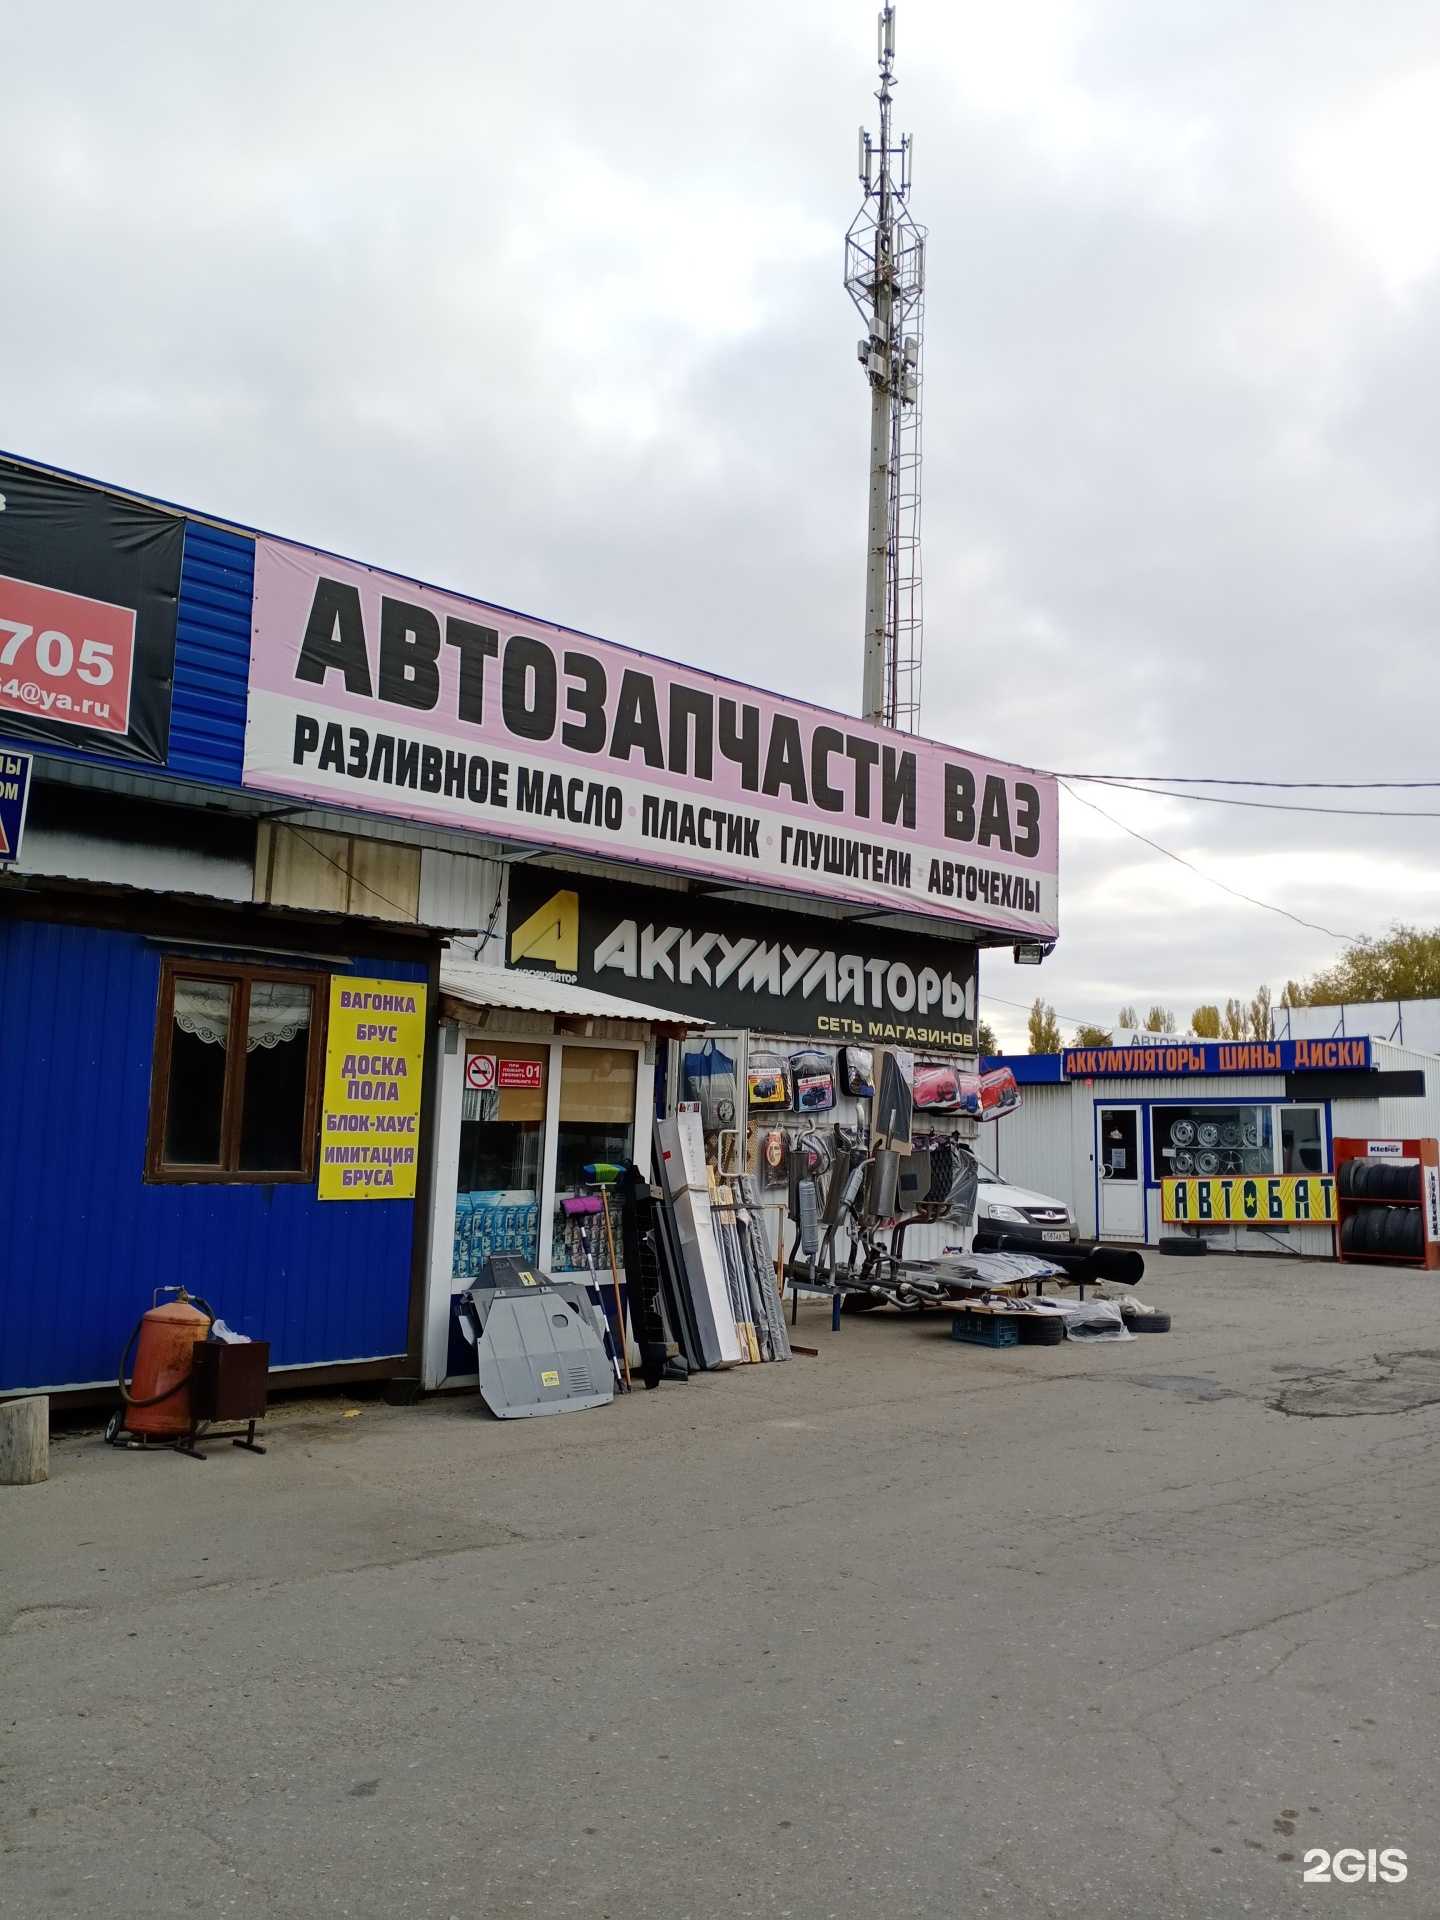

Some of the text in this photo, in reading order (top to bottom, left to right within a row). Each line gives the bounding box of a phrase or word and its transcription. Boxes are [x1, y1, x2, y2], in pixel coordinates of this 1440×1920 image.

[0, 677, 110, 718] 4@ya.ru
[294, 576, 1041, 858] АВТОЗАПЧАСТИ ВАЗ
[293, 714, 1041, 914] РАЗЛИВНОЕ МАСЛО ПЛАСТИК ГЛУШИТЕЛИ АВТОЧЕХЛЫ
[594, 919, 976, 1021] АККУМУЛЯТОРЫ
[340, 991, 417, 1014] ВАГОНКА
[356, 1023, 398, 1043] БРУС
[817, 1016, 974, 1048] СЕТЬ МАГАЗИНОВ
[341, 1054, 408, 1079] ДОСКА
[1066, 1040, 1366, 1073] АККУМУЛЯТОРЫ ШИНЫ ДИСКИ
[526, 1064, 540, 1078] 01
[347, 1080, 400, 1101] ПОЛА
[326, 1114, 416, 1133] БЛОК-ХАУС
[324, 1146, 415, 1167] ИМИТАЦИЯ
[342, 1169, 395, 1187] БРУСА
[1174, 1178, 1334, 1219] АВТОБАТ
